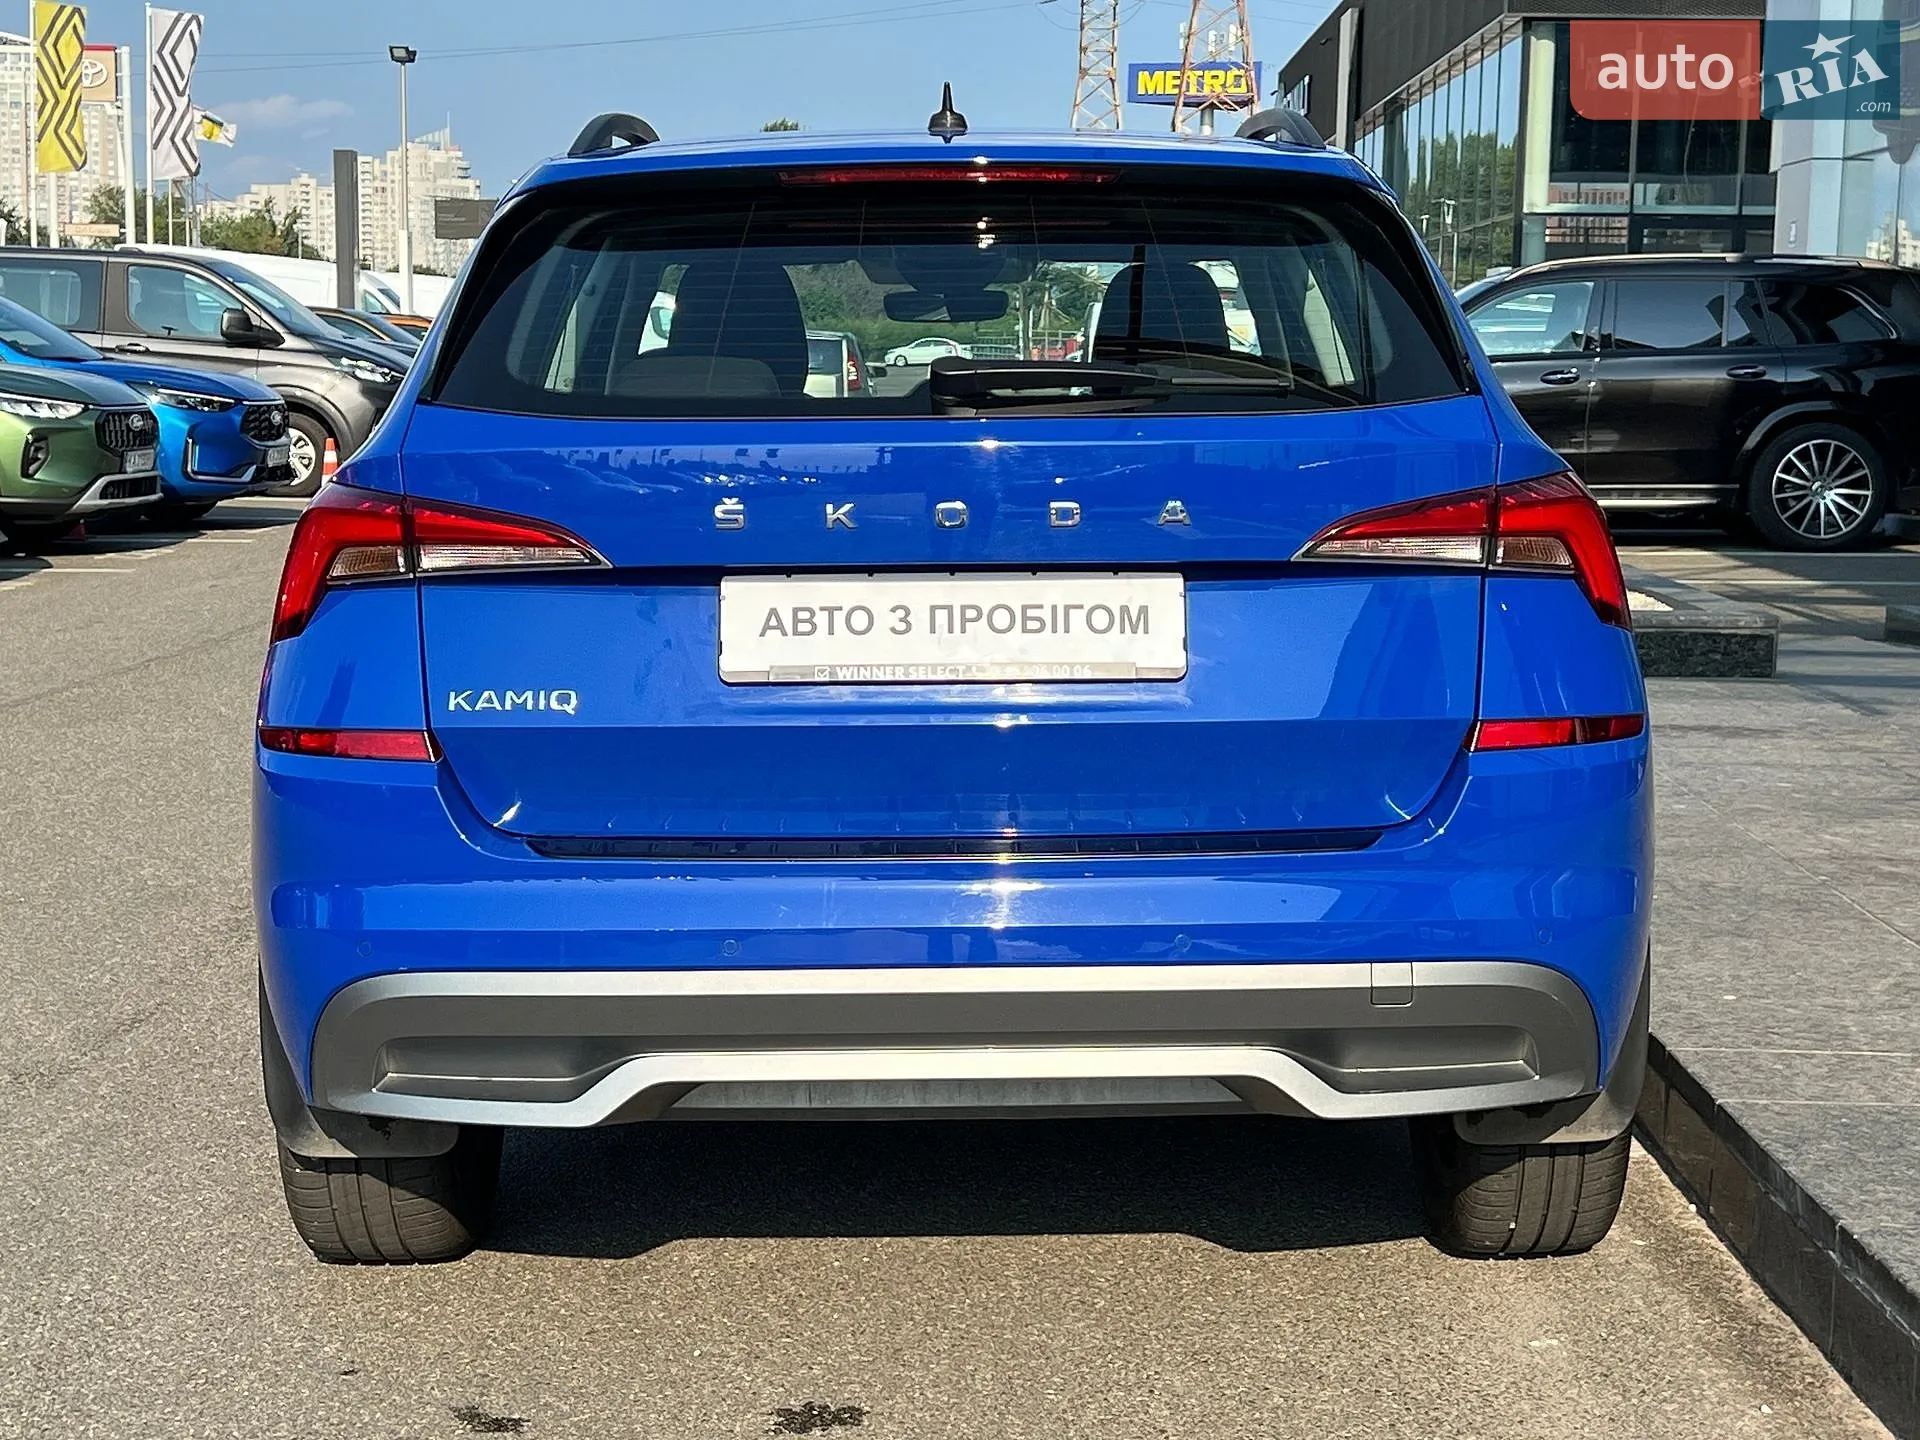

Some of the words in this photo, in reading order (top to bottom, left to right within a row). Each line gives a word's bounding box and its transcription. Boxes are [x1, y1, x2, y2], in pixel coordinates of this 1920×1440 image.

[1137, 69, 1249, 95] METRO
[713, 496, 1192, 531] ŠKODA
[759, 606, 875, 638] АВТО
[889, 604, 912, 636] З
[929, 603, 1150, 636] ПРОБІГОМ
[835, 665, 904, 680] WINNER
[908, 664, 967, 679] SELECT
[447, 689, 579, 716] KAMIQ
